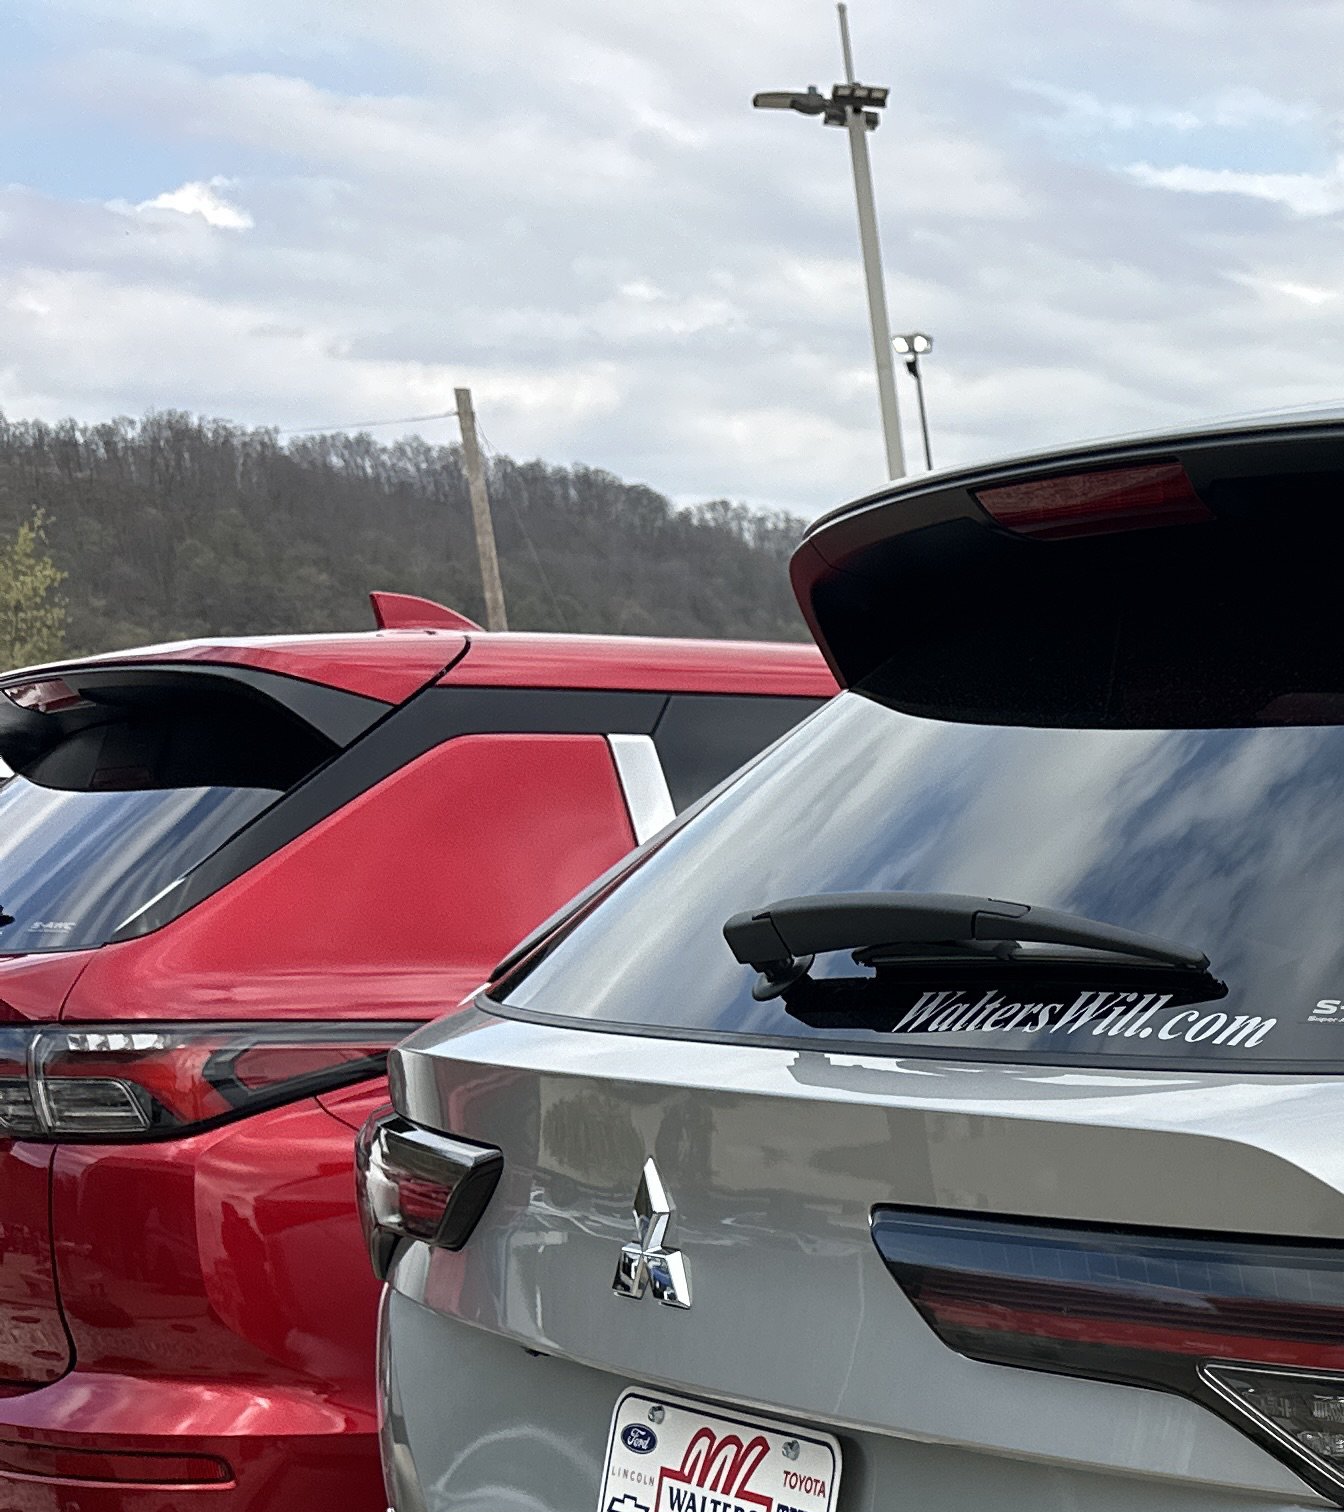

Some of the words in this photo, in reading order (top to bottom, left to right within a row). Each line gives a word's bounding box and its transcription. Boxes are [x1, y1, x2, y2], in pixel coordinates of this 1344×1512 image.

[891, 989, 1278, 1048] WaltersWill.com
[611, 1466, 656, 1487] LINCOLN
[782, 1470, 827, 1499] TOYOTA
